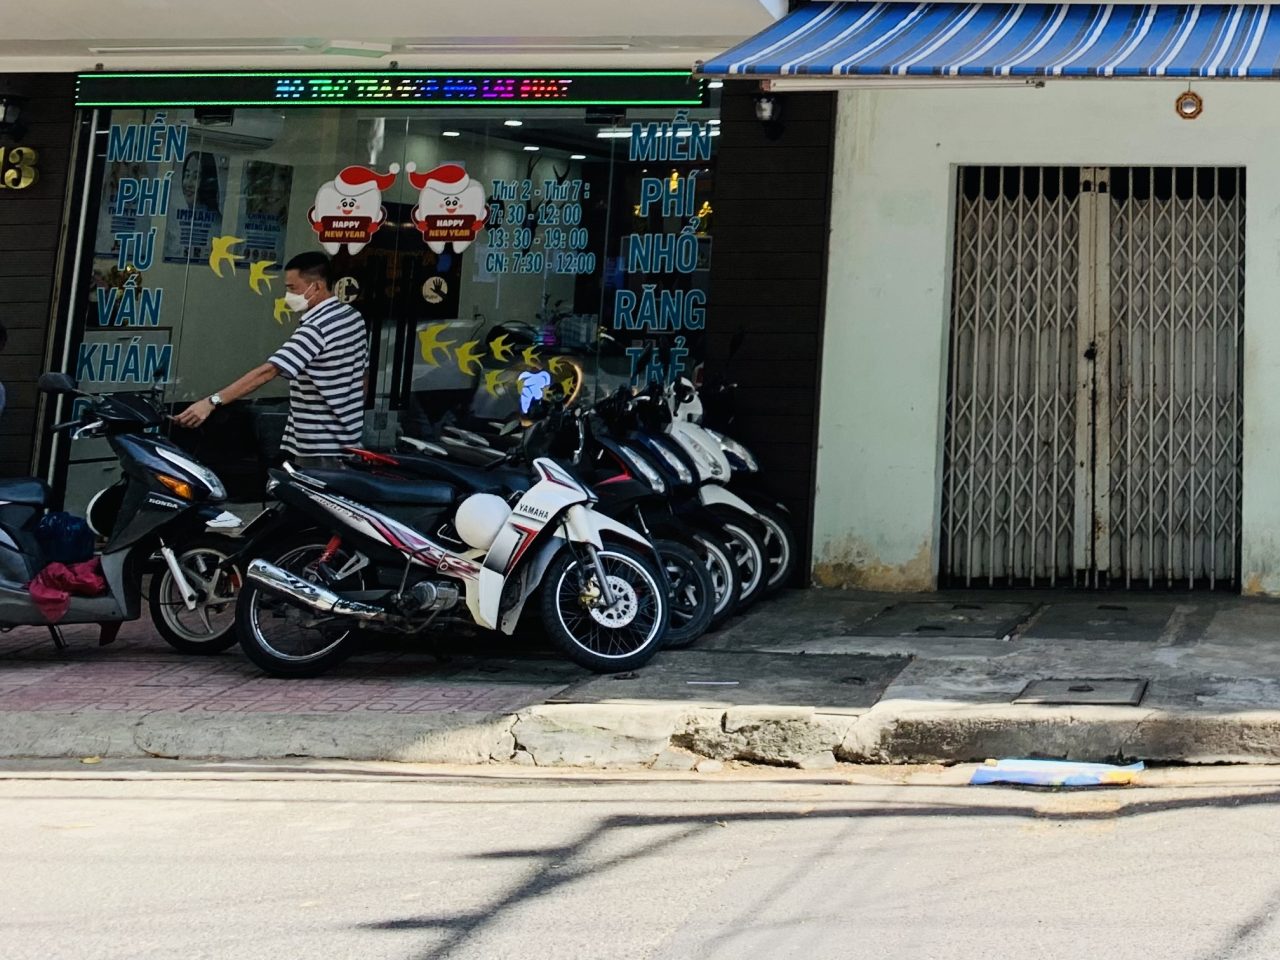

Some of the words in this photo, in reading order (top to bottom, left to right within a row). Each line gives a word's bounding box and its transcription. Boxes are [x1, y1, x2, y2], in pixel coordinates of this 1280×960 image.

[107, 112, 188, 163] MIỄN
[629, 109, 712, 161] MIỄN
[115, 170, 175, 217] PHÍ
[492, 180, 519, 201] Thứ
[521, 180, 532, 200] 2
[543, 180, 572, 201] Thứ
[640, 169, 700, 217] PHÍ
[332, 220, 360, 229] HAPPY
[436, 219, 464, 228] HAPPY
[507, 203, 526, 225] 30
[562, 203, 582, 225] 00
[325, 230, 344, 238] NEW
[345, 230, 365, 239] YEAR
[429, 229, 448, 237] NEW
[450, 229, 470, 237] YEAR
[512, 227, 532, 249] 30
[568, 227, 588, 249] 00
[628, 216, 701, 273] NHỔ
[116, 227, 157, 272] TƯ
[486, 251, 508, 273] CN:
[511, 251, 543, 273] 7:30
[556, 251, 596, 274] 12:00
[97, 274, 163, 327] VẤN
[613, 283, 706, 330] RĂNG
[76, 336, 173, 384] KHÁM
[148, 497, 178, 509] HONDA
[519, 503, 549, 520] YAMAHA
